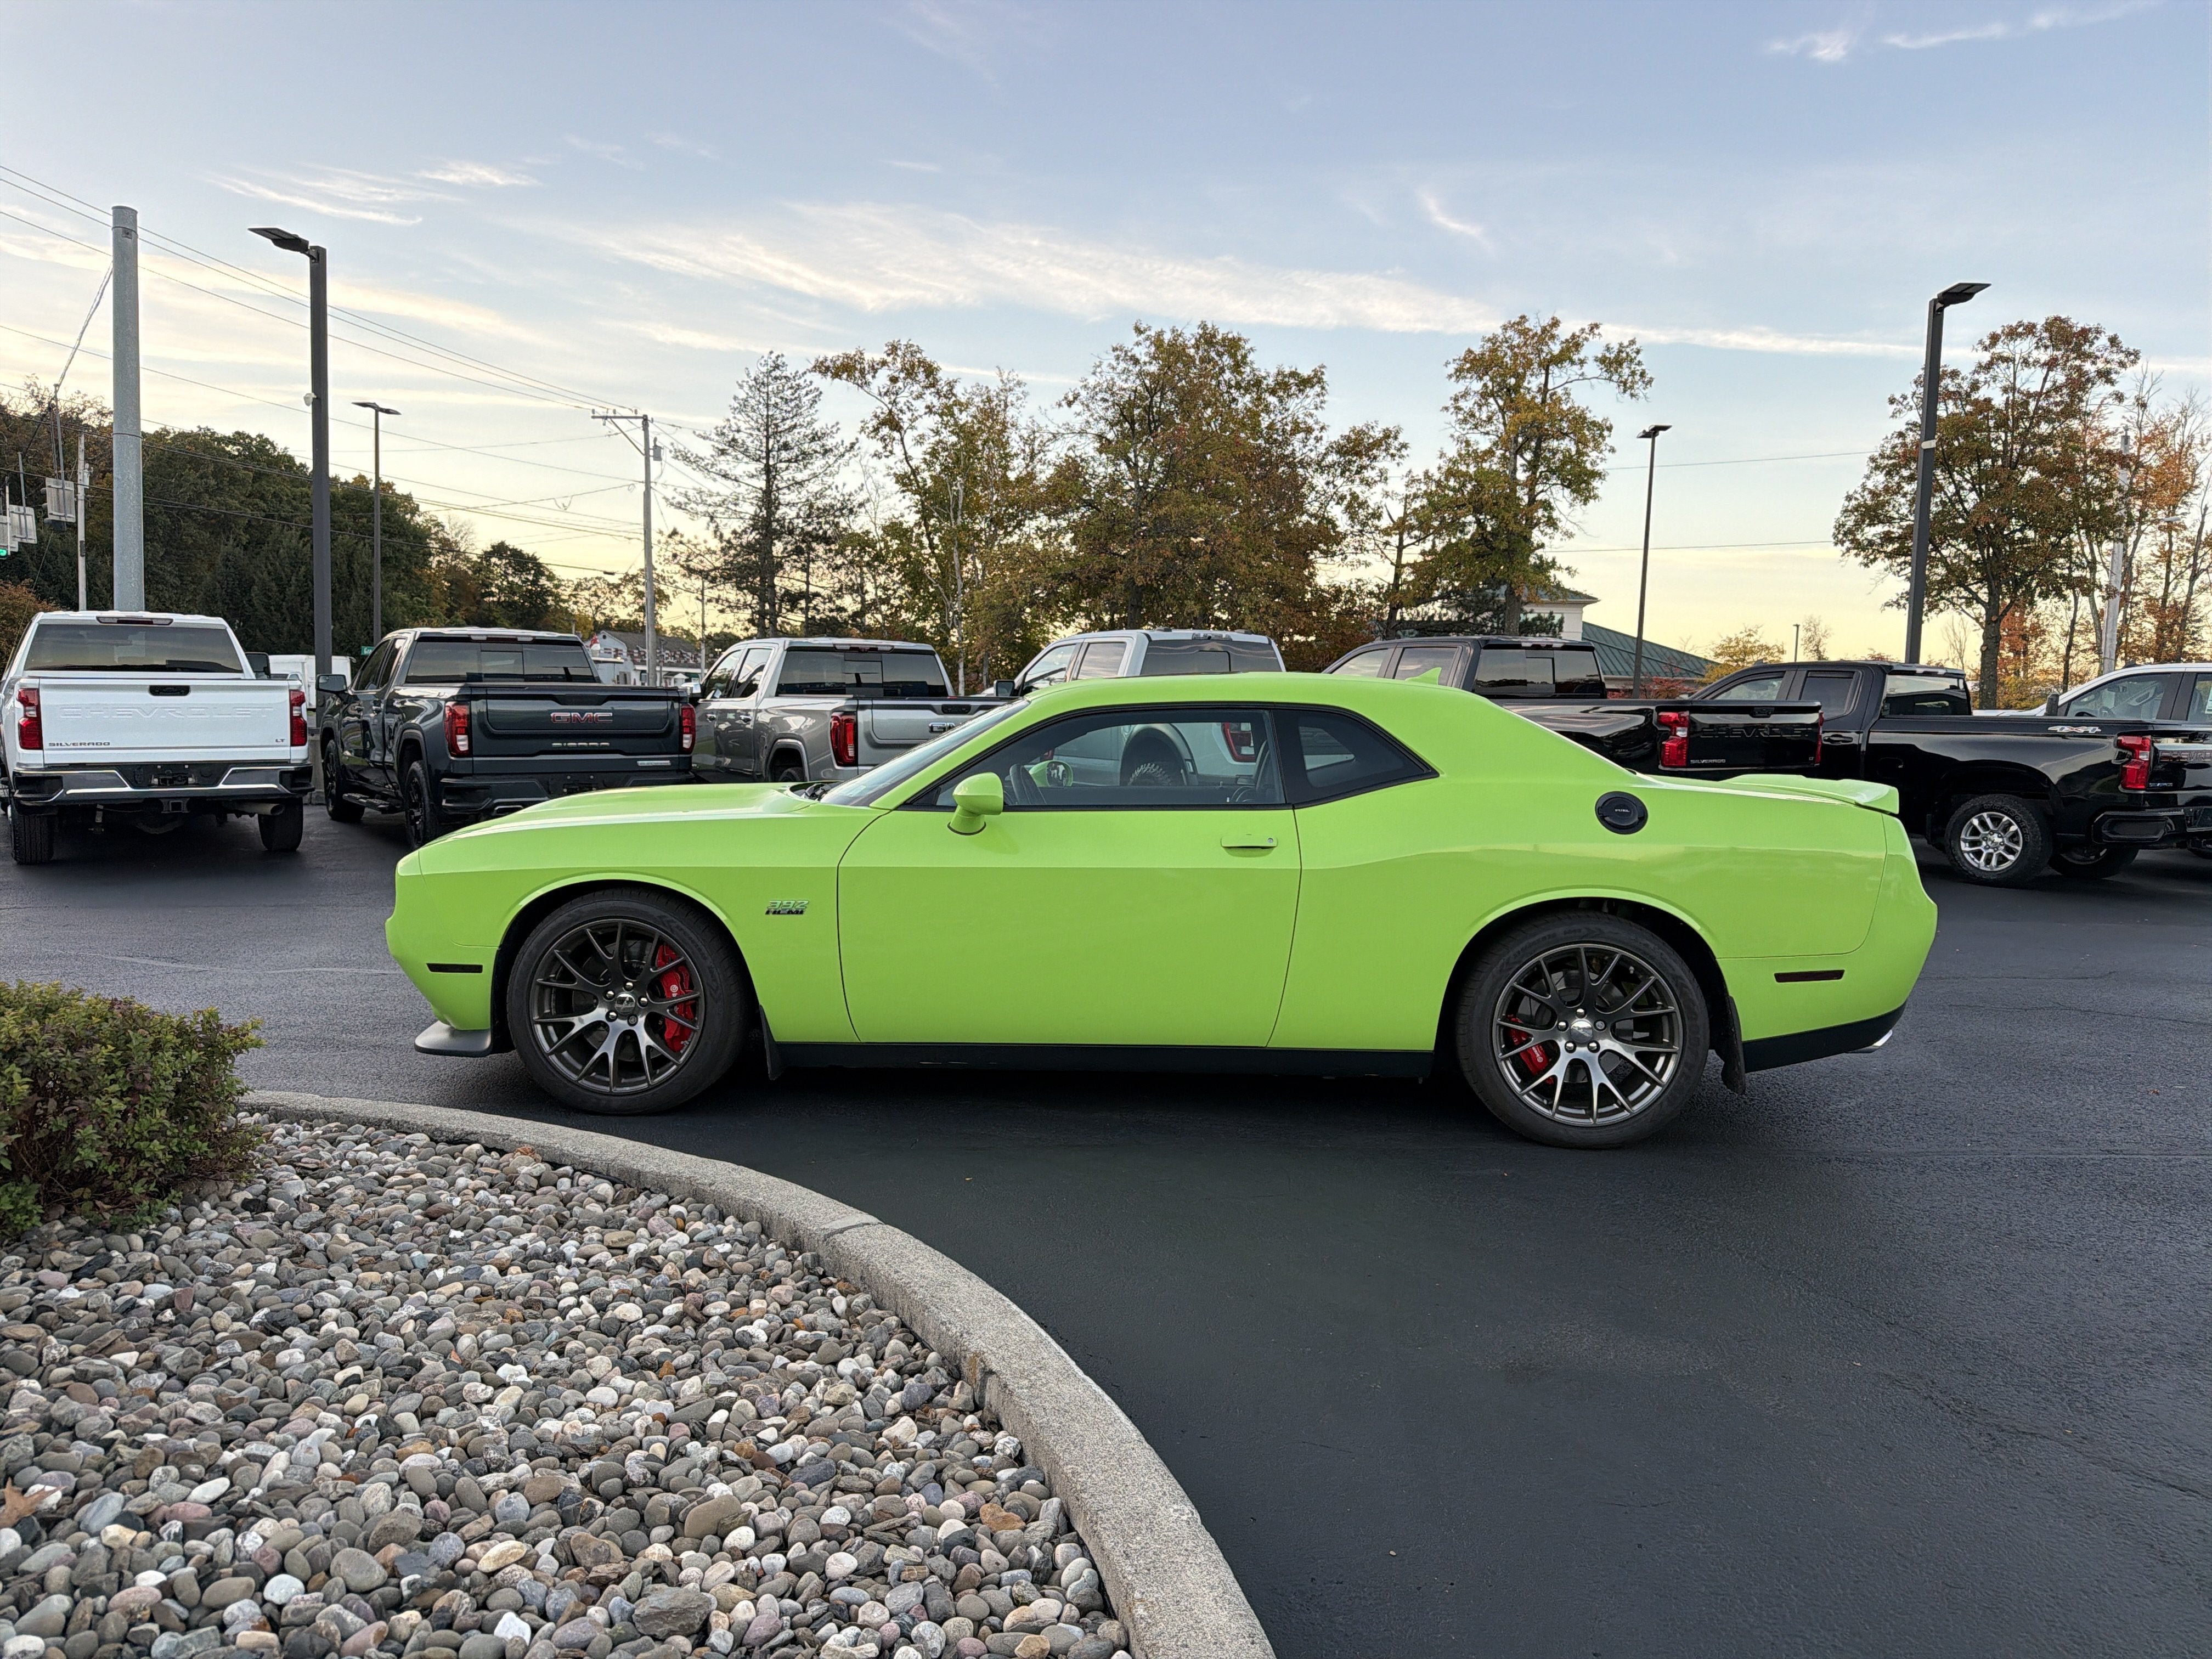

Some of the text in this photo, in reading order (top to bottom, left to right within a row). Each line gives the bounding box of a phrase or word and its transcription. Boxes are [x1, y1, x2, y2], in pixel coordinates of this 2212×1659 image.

[60, 707, 274, 719] CHEVROLET
[550, 713, 613, 723] GMC
[1700, 728, 1813, 738] CHEVROLET
[768, 900, 809, 909] 392
